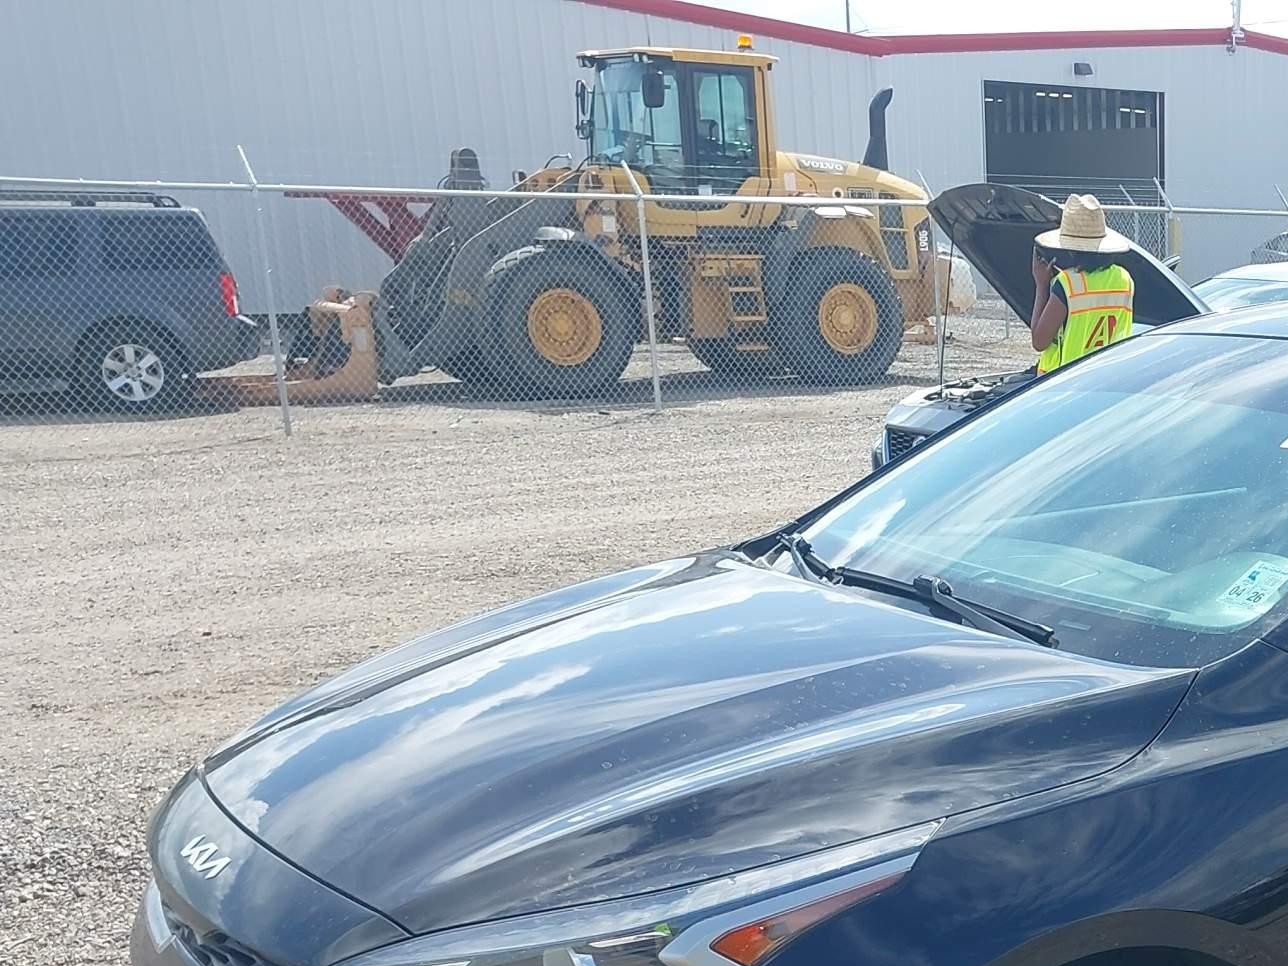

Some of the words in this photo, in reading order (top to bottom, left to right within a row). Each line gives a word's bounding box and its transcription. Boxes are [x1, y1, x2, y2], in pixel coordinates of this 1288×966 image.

[800, 159, 843, 171] VOLVO
[1228, 585, 1246, 597] 04
[1246, 591, 1265, 603] 26
[180, 834, 232, 880] KIA
